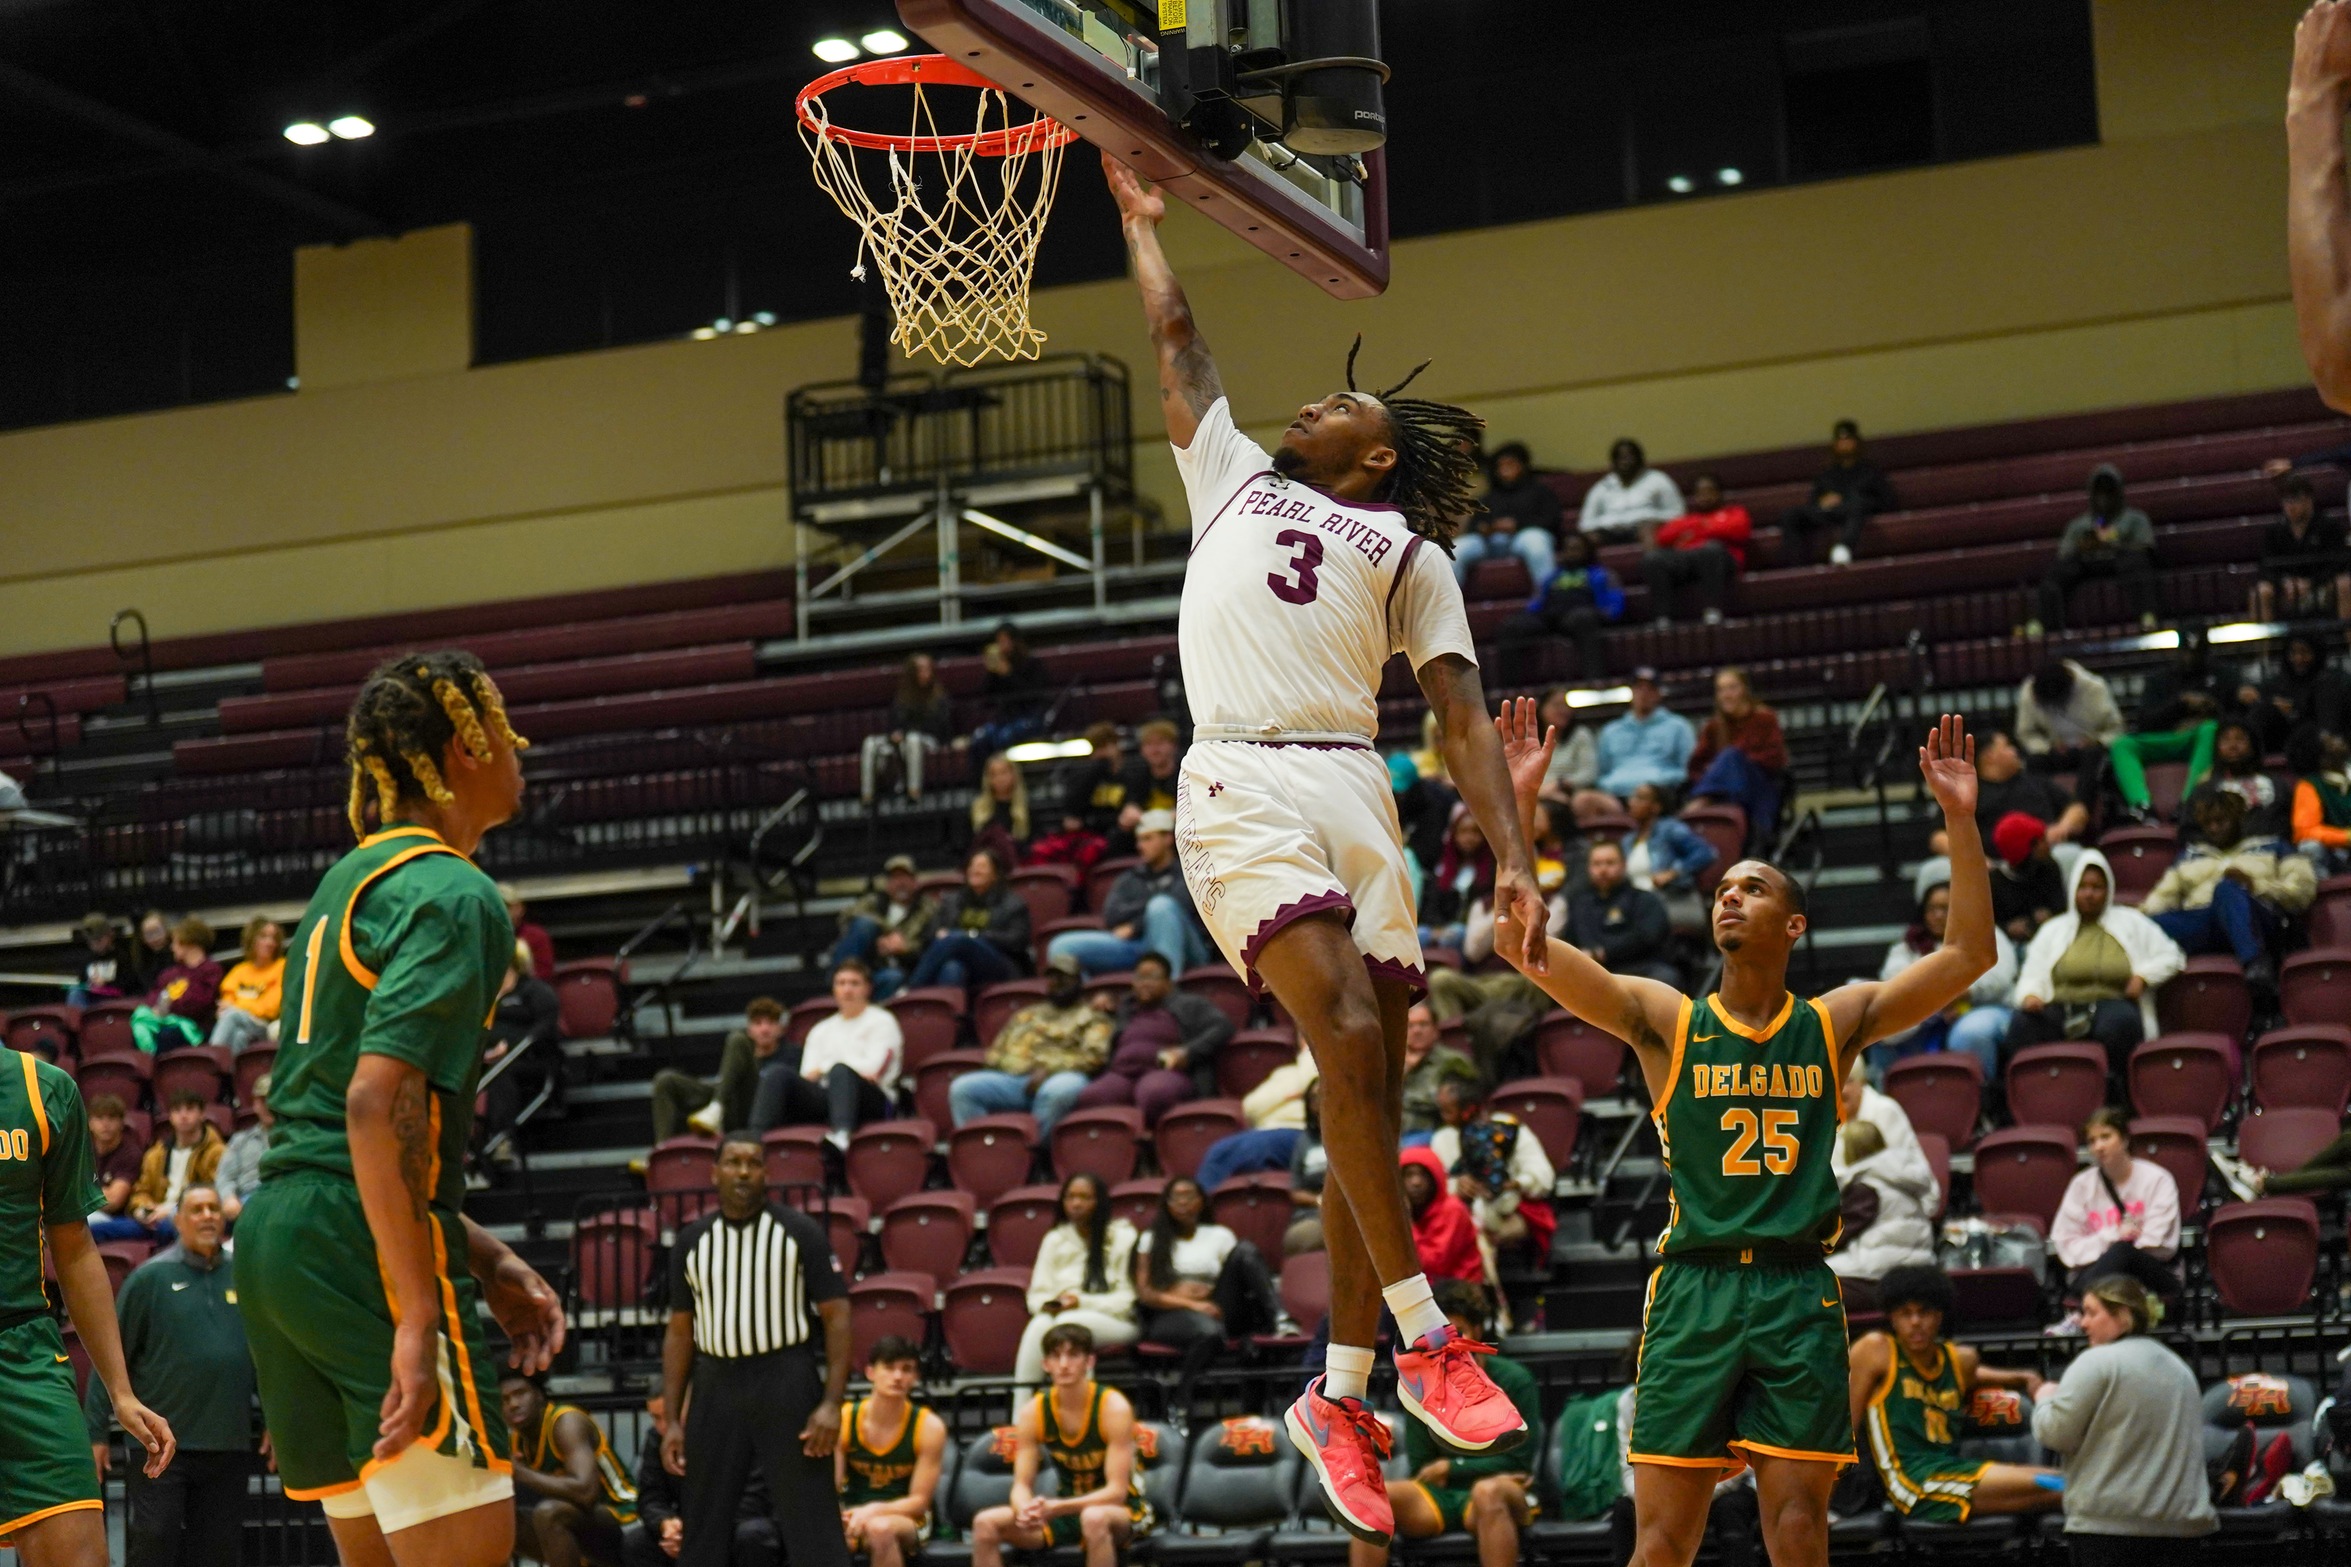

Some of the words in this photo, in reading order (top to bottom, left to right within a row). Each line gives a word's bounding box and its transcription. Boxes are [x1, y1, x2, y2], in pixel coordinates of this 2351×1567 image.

[1238, 490, 1316, 523] PEARL
[1319, 512, 1393, 569] RIVER
[1267, 528, 1325, 606] 3
[296, 914, 329, 1044] 1
[1693, 1063, 1823, 1099] DELGADO
[1721, 1107, 1800, 1176] 25
